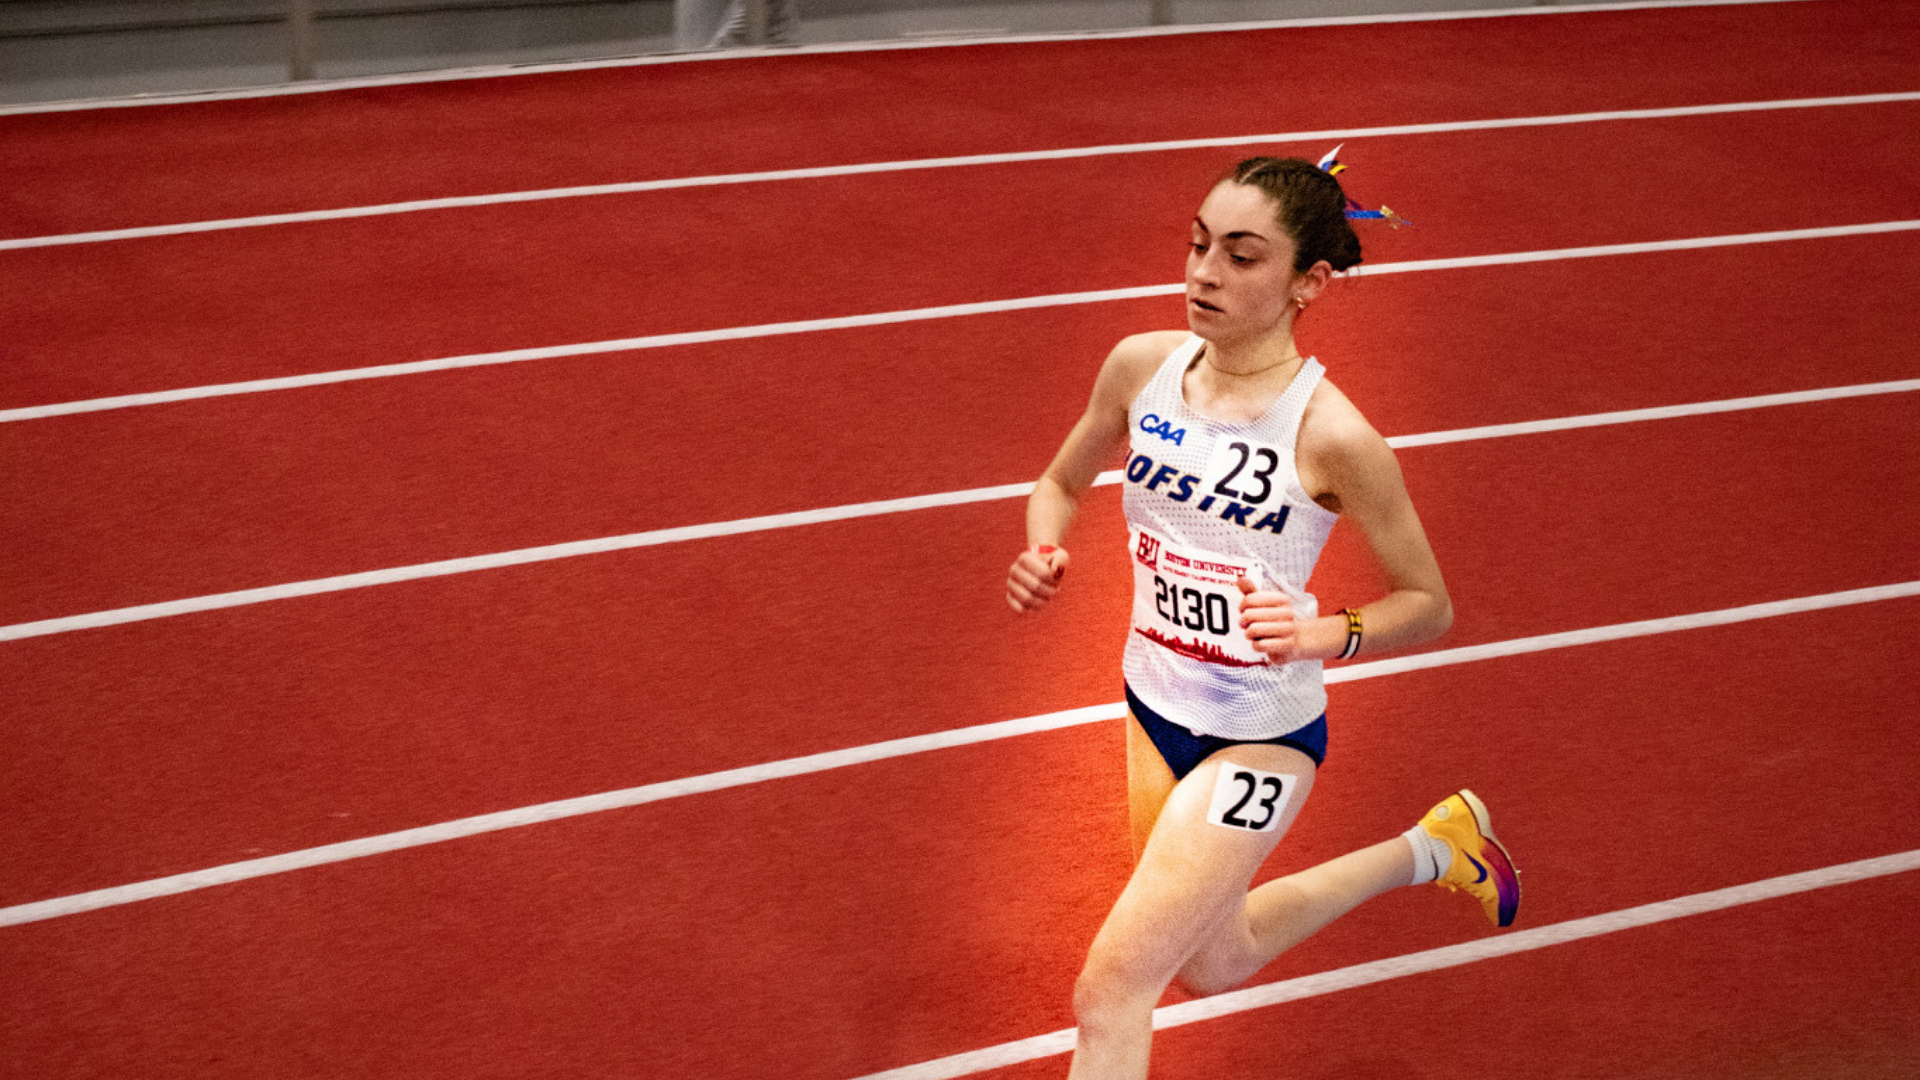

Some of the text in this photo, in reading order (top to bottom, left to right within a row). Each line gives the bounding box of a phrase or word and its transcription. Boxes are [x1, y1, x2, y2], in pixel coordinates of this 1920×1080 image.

[1140, 414, 1186, 446] CAA
[1126, 449, 1291, 534] OFSRA
[1214, 442, 1279, 505] 23
[1137, 531, 1161, 562] BU
[1193, 560, 1247, 577] UNIVERSITY
[1154, 575, 1230, 636] 2130
[1221, 771, 1283, 830] 23
